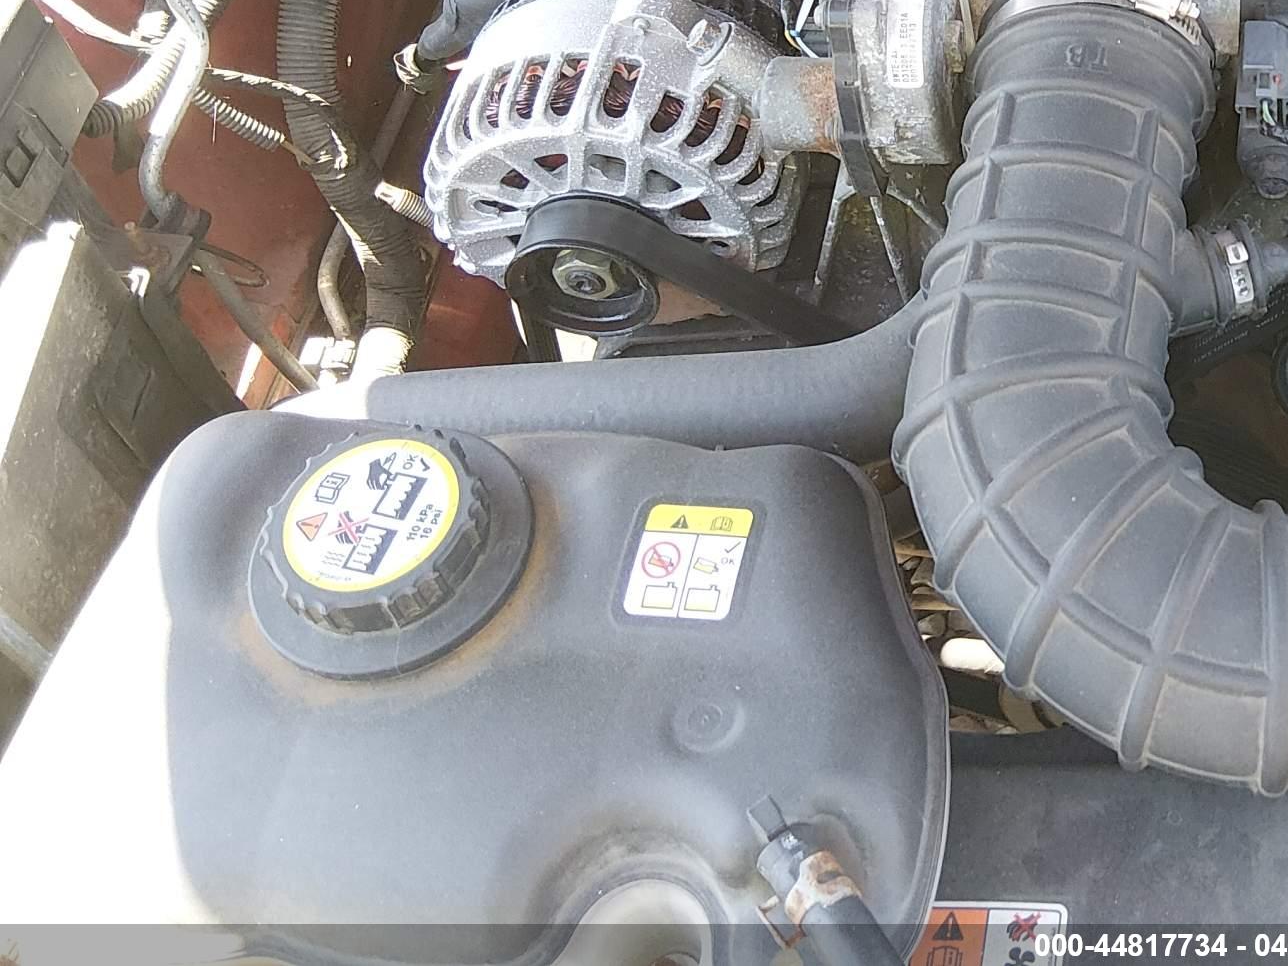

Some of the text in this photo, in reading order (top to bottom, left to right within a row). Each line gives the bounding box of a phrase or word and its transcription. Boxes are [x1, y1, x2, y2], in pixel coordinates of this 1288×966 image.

[402, 454, 419, 471] OK
[416, 503, 434, 523] kPa
[720, 556, 735, 566] OK
